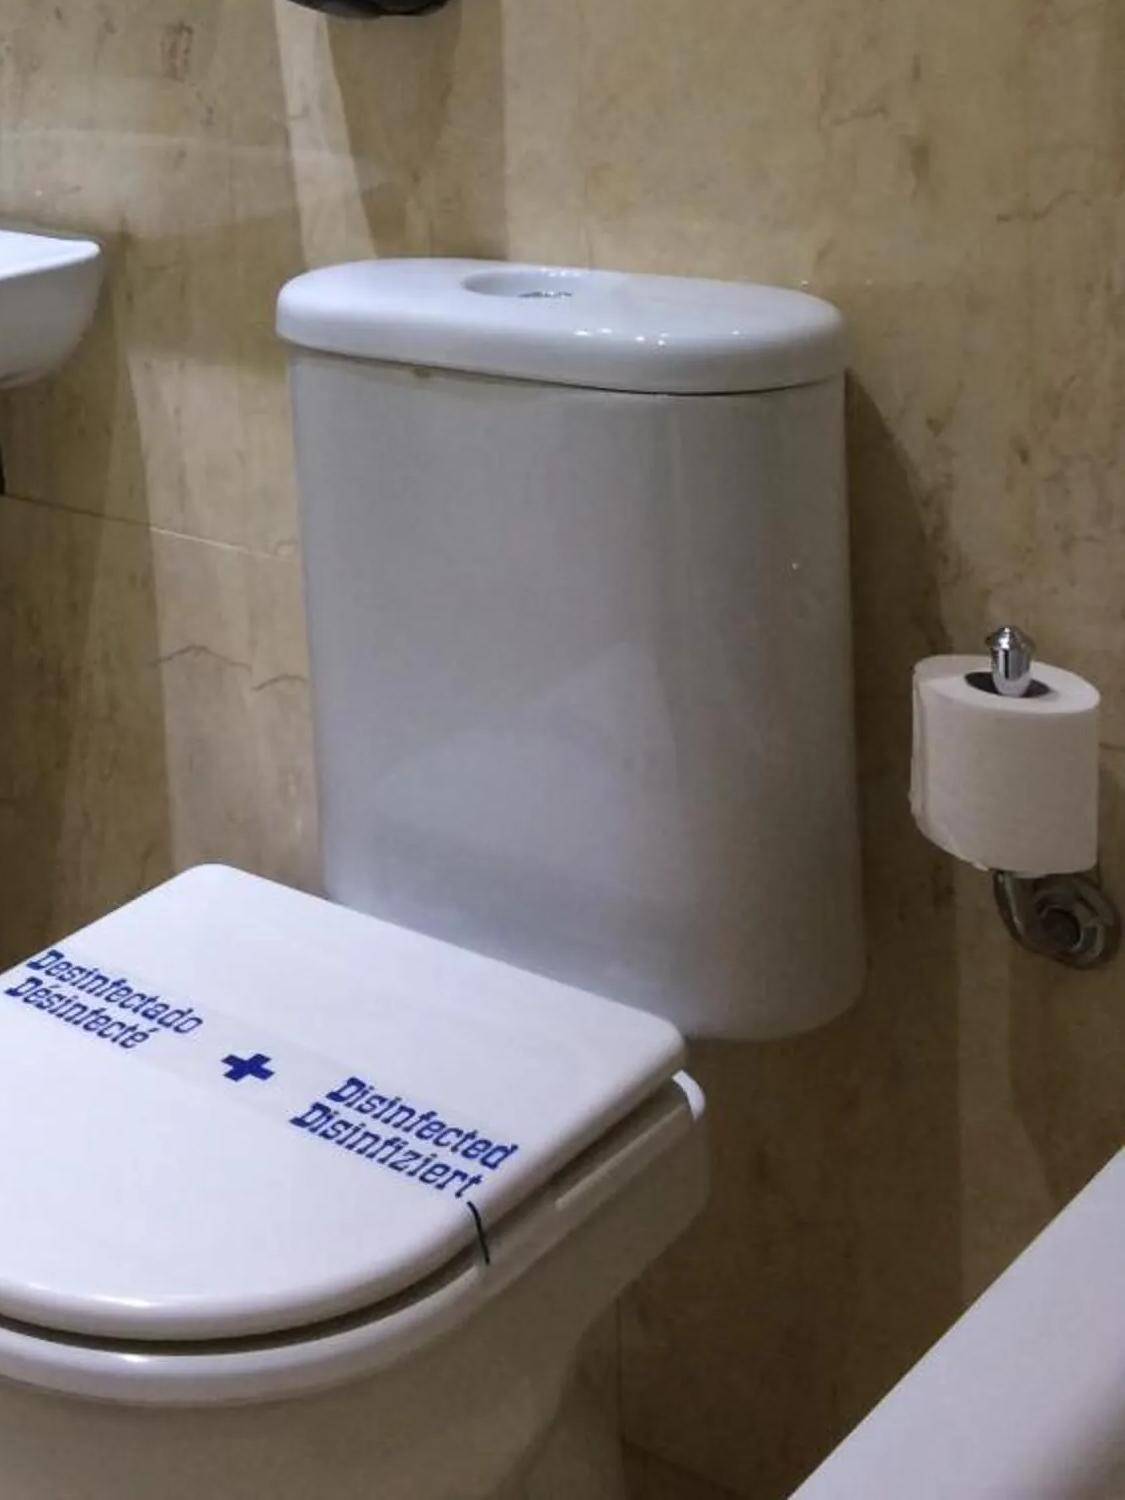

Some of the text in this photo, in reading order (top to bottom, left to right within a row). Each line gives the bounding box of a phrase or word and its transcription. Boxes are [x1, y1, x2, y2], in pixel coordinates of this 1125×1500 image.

[4, 976, 160, 1049] Désinfecté
[27, 949, 203, 1034] Desinfectado
[289, 1102, 483, 1199] Disinfiziert
[325, 1076, 518, 1170] Disinfected
